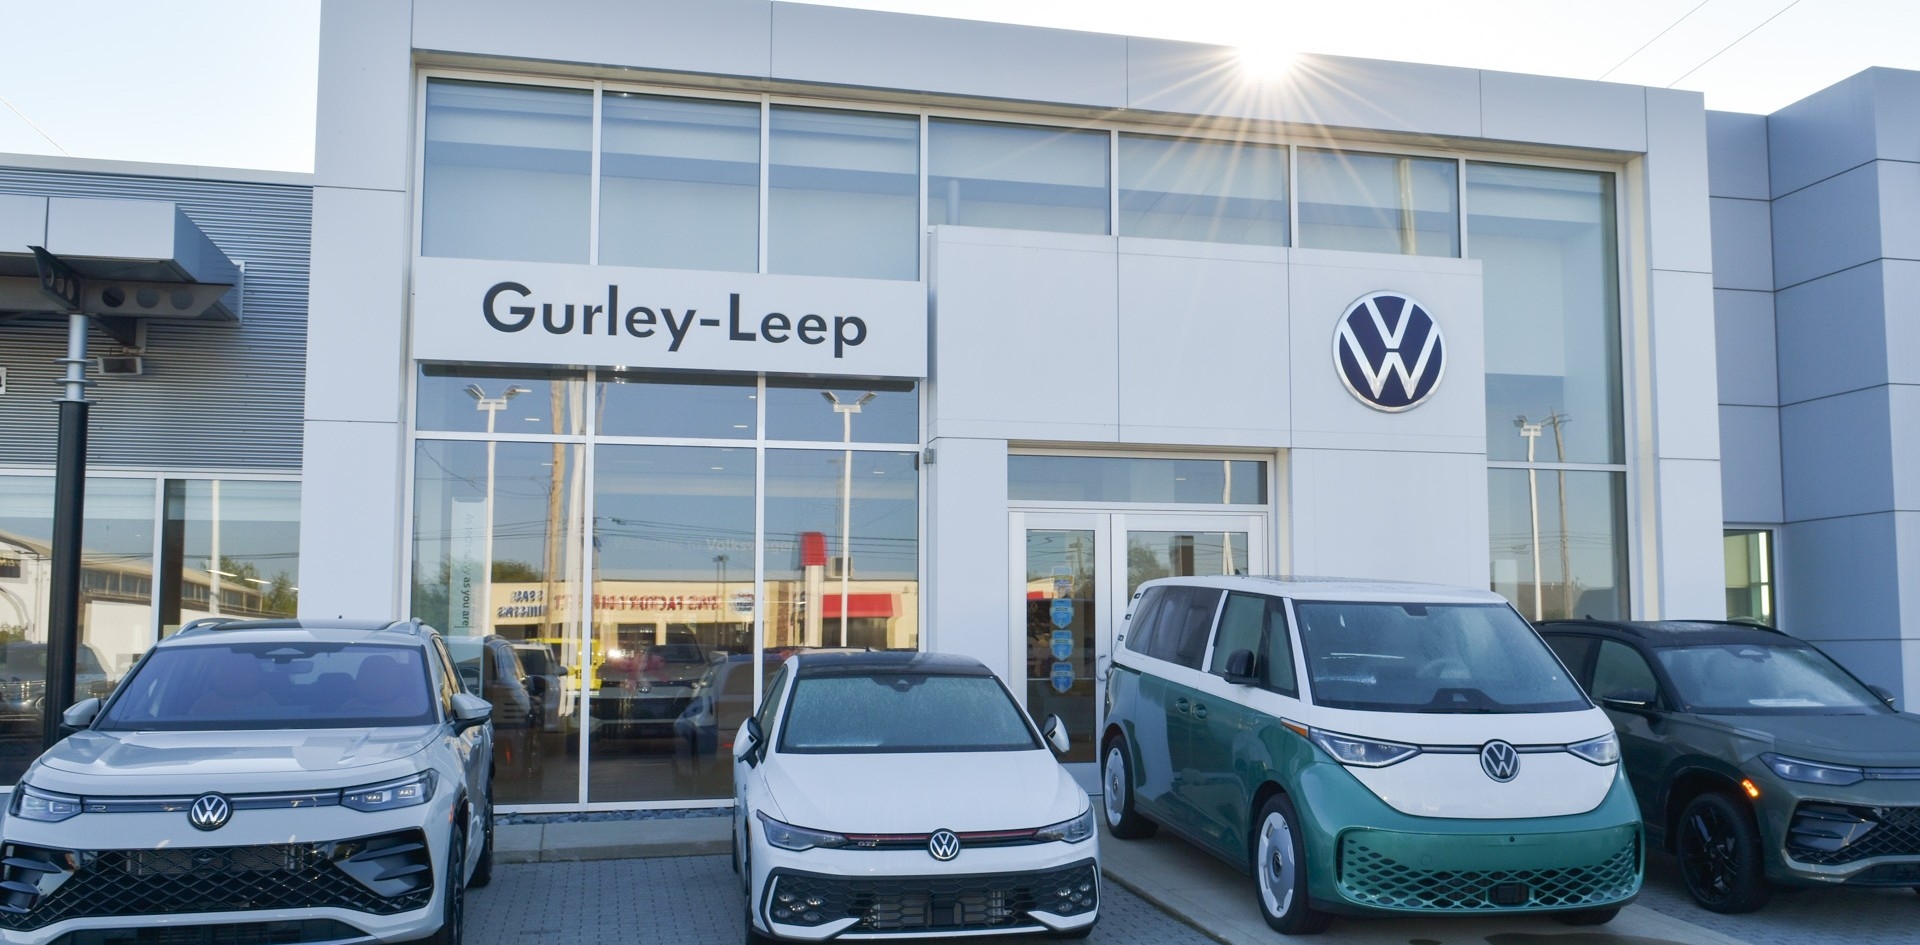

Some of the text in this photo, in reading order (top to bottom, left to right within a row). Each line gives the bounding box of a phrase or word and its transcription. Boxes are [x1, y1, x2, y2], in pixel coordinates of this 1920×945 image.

[482, 281, 868, 359] Gurley-Leep
[1333, 290, 1447, 413] VW
[460, 589, 470, 608] you
[463, 576, 471, 588] as
[462, 610, 470, 627] are
[1481, 740, 1520, 783] VW
[190, 793, 230, 829] VW
[929, 830, 960, 860] VW
